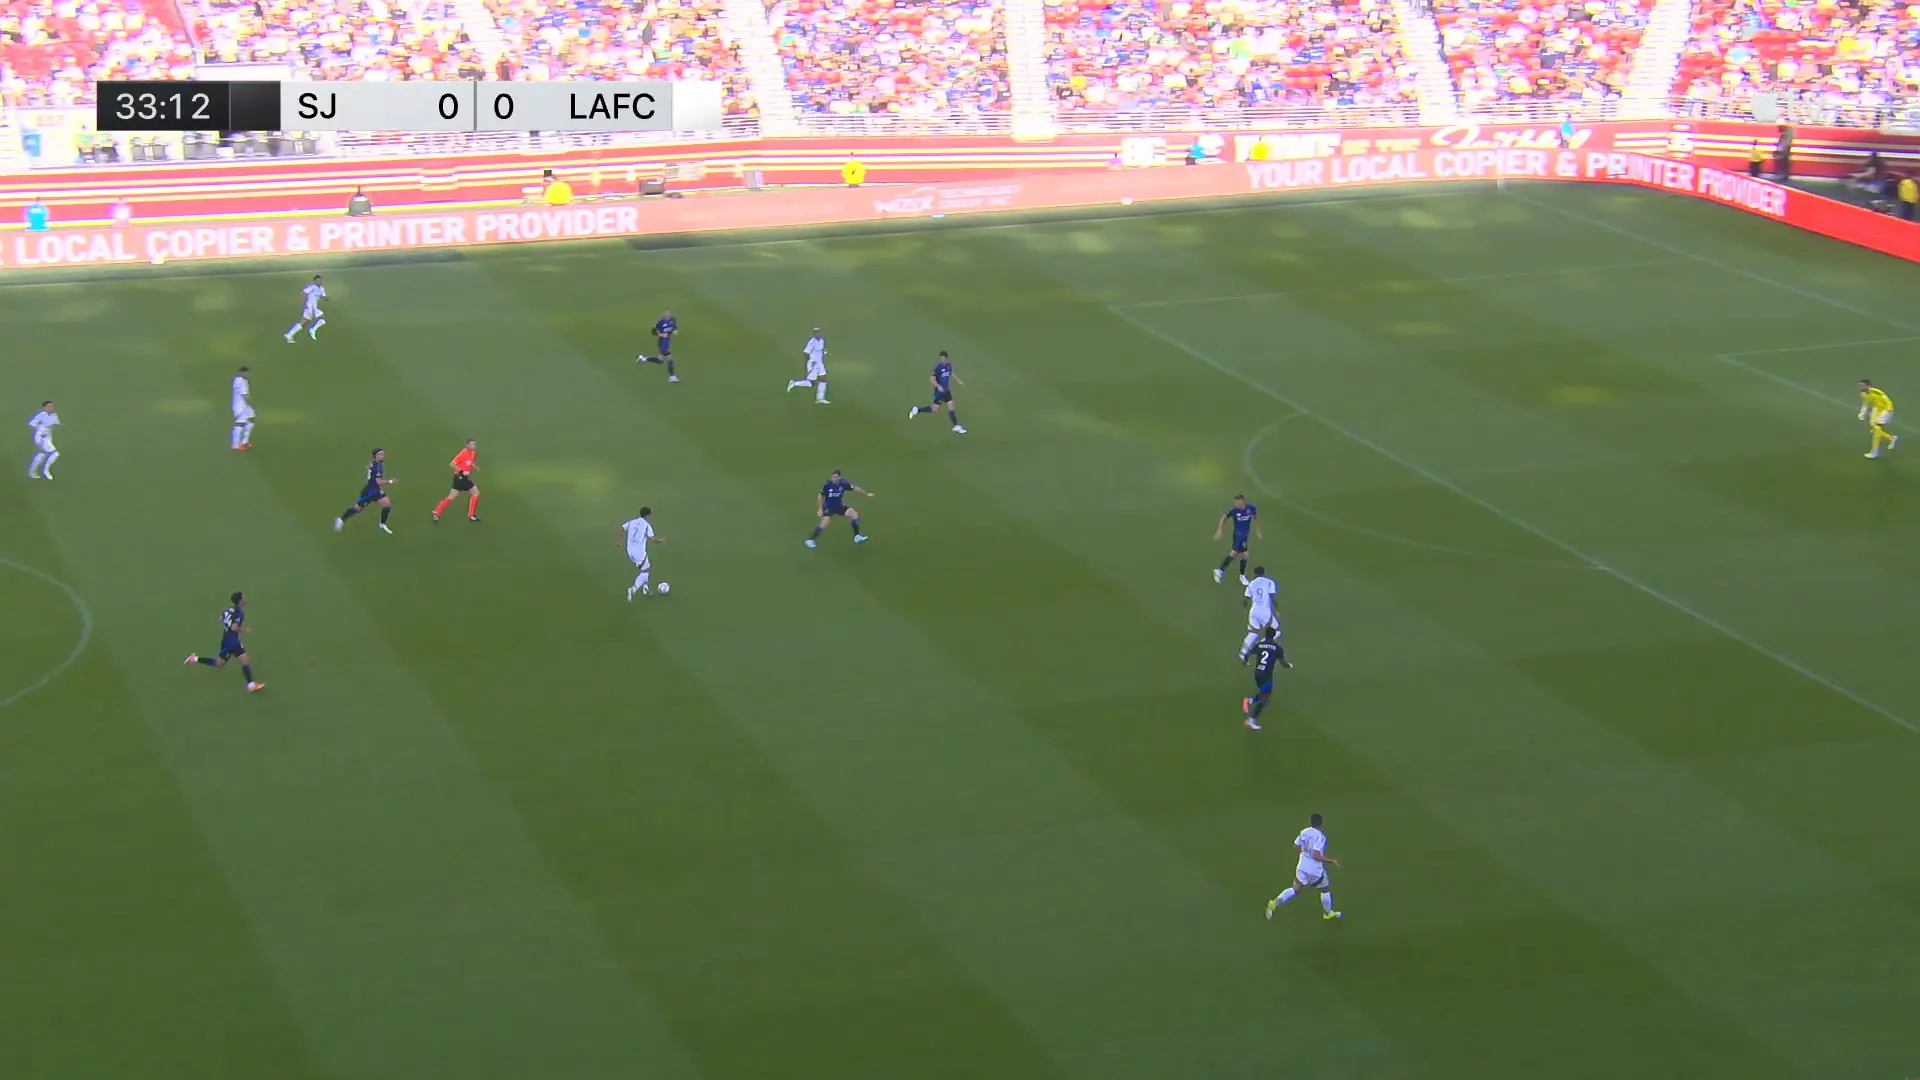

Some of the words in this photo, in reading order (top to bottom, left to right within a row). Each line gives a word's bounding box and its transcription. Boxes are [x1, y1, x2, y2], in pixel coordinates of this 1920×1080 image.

[1246, 159, 1324, 189] YOUR
[1332, 153, 1427, 183] LOCAL
[1433, 149, 1546, 178] COPIER
[1556, 152, 1578, 177] &
[1586, 152, 1695, 191] PRINTER
[1697, 167, 1787, 217] PROVIDER
[13, 233, 137, 265] LOCAL
[147, 226, 275, 259] COPIER
[286, 225, 312, 252] &
[320, 216, 467, 249] PRINTER
[474, 206, 640, 242] PROVIDER
[1260, 651, 1269, 664] 2
